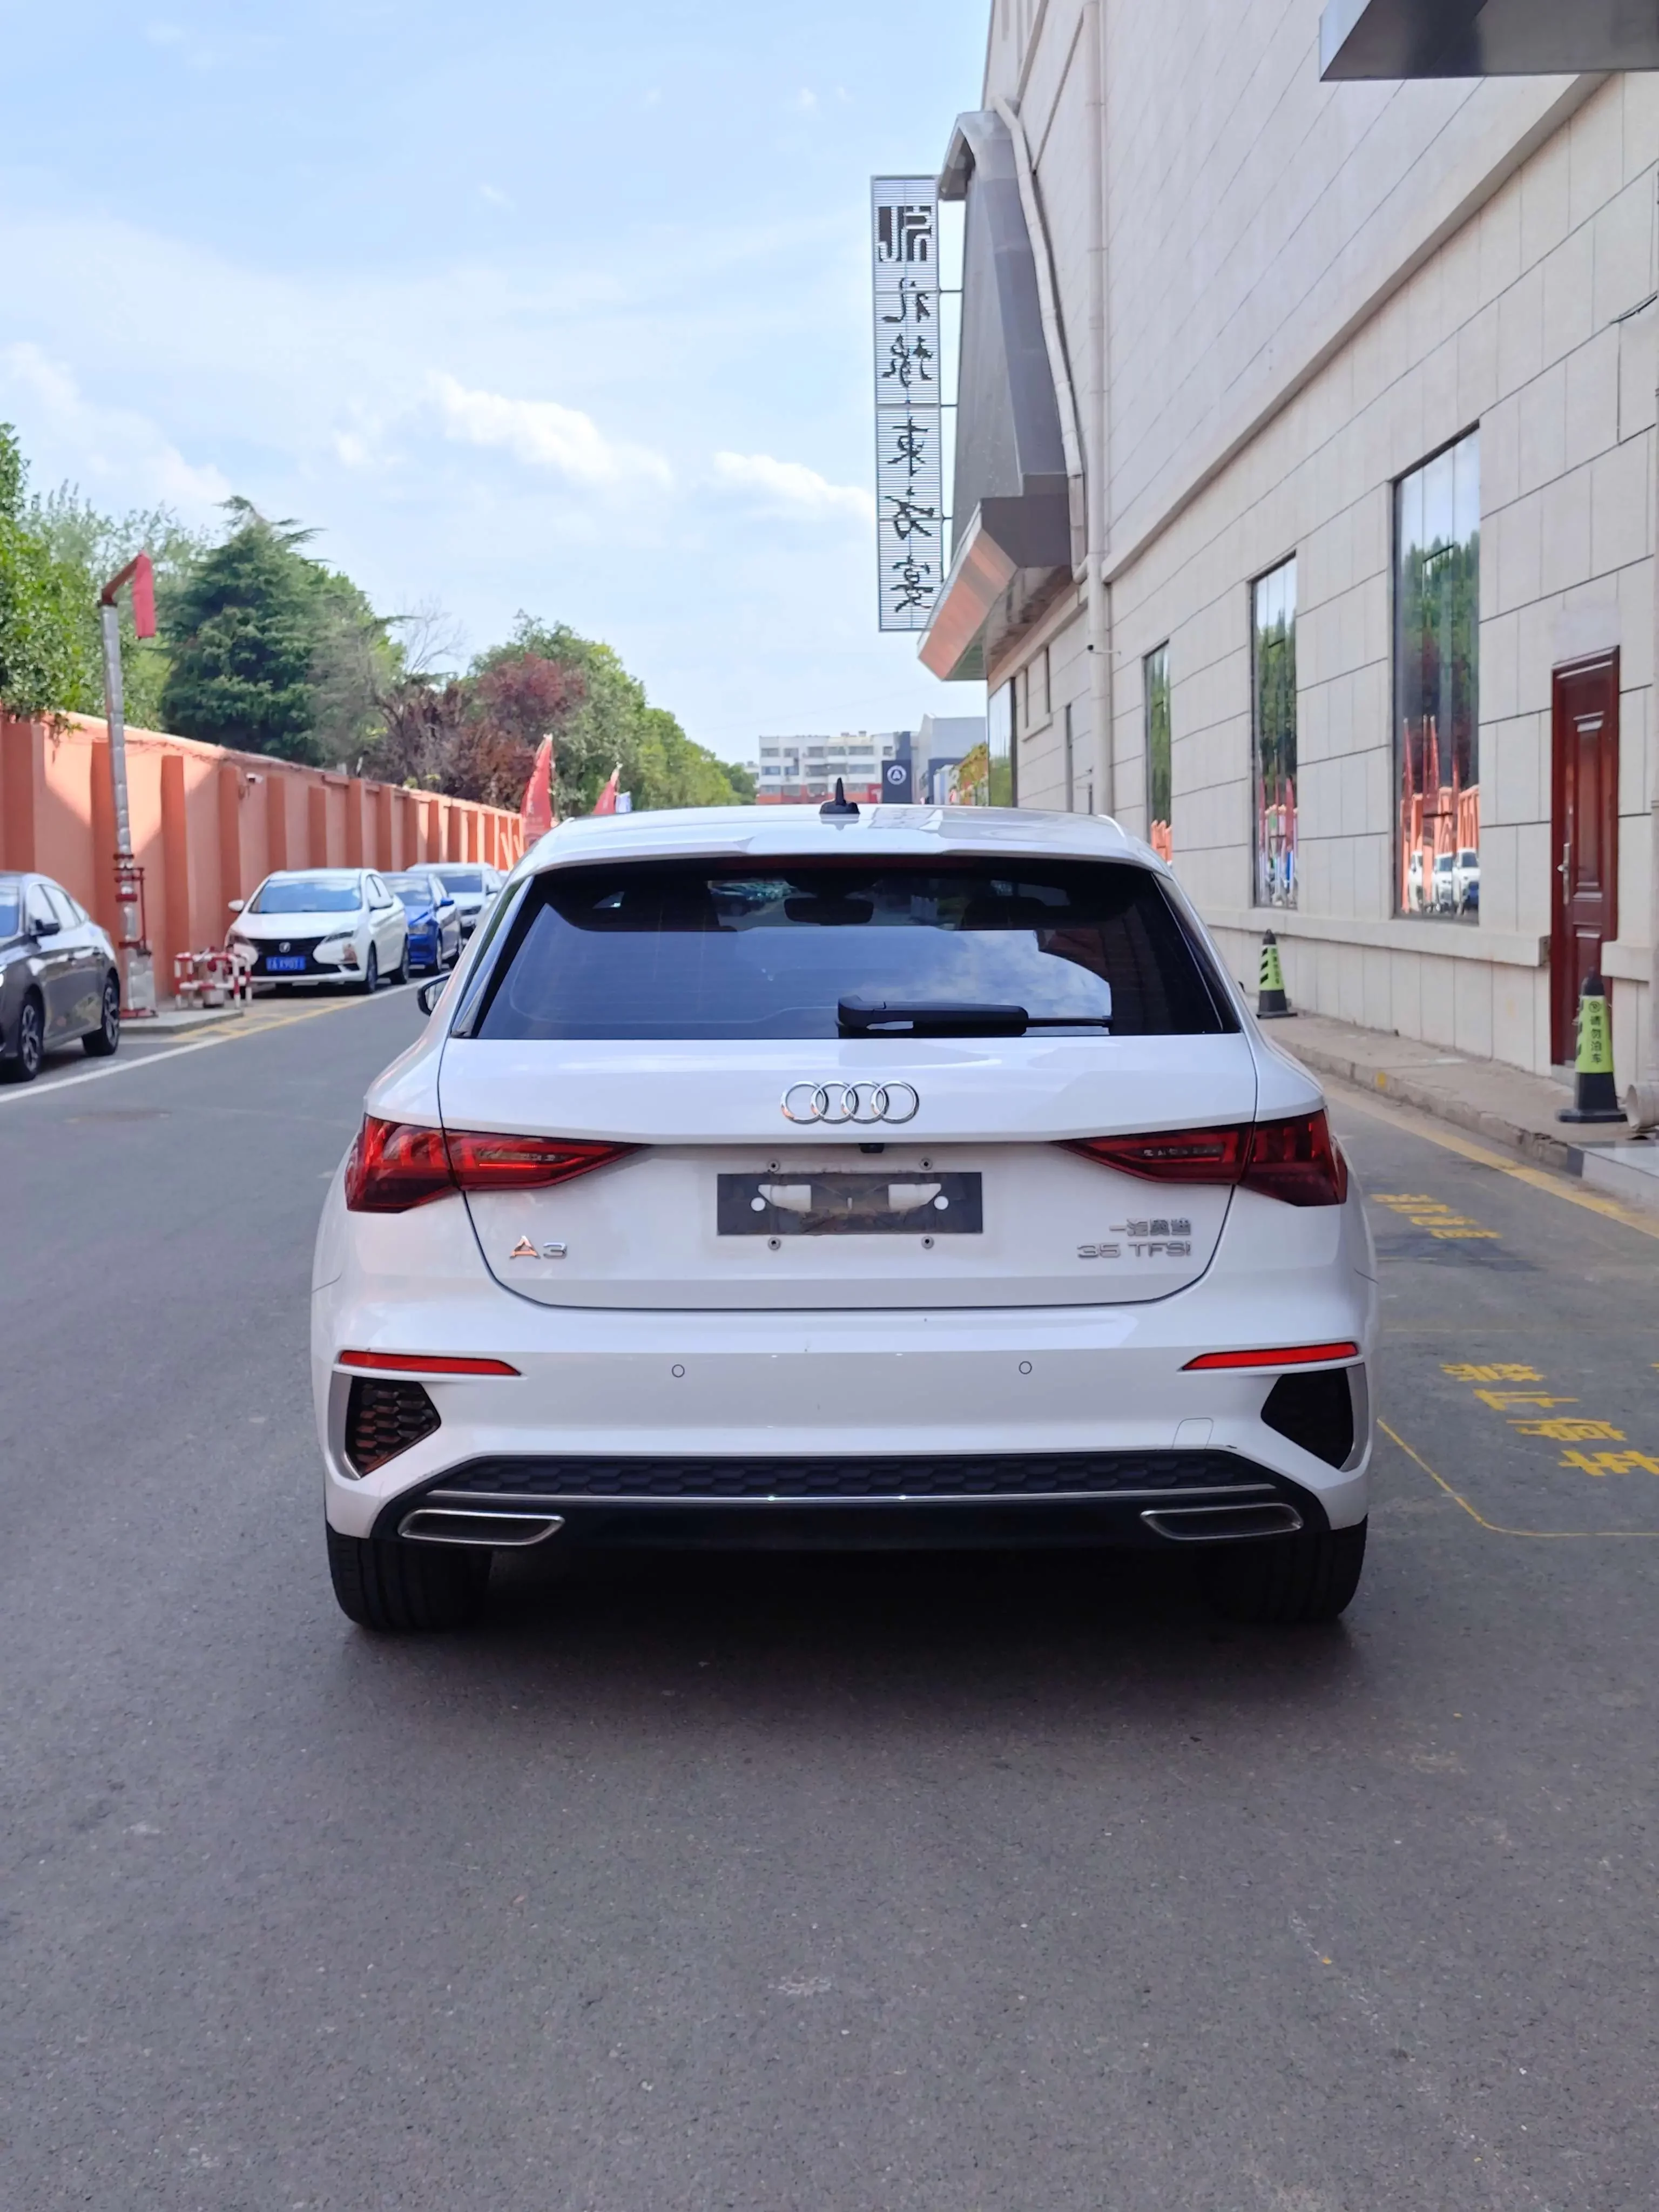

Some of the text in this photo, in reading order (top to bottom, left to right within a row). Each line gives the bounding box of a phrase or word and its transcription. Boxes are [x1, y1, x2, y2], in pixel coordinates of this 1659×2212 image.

[509, 1235, 568, 1259] A3
[1077, 1240, 1191, 1260] 35 TFSI
